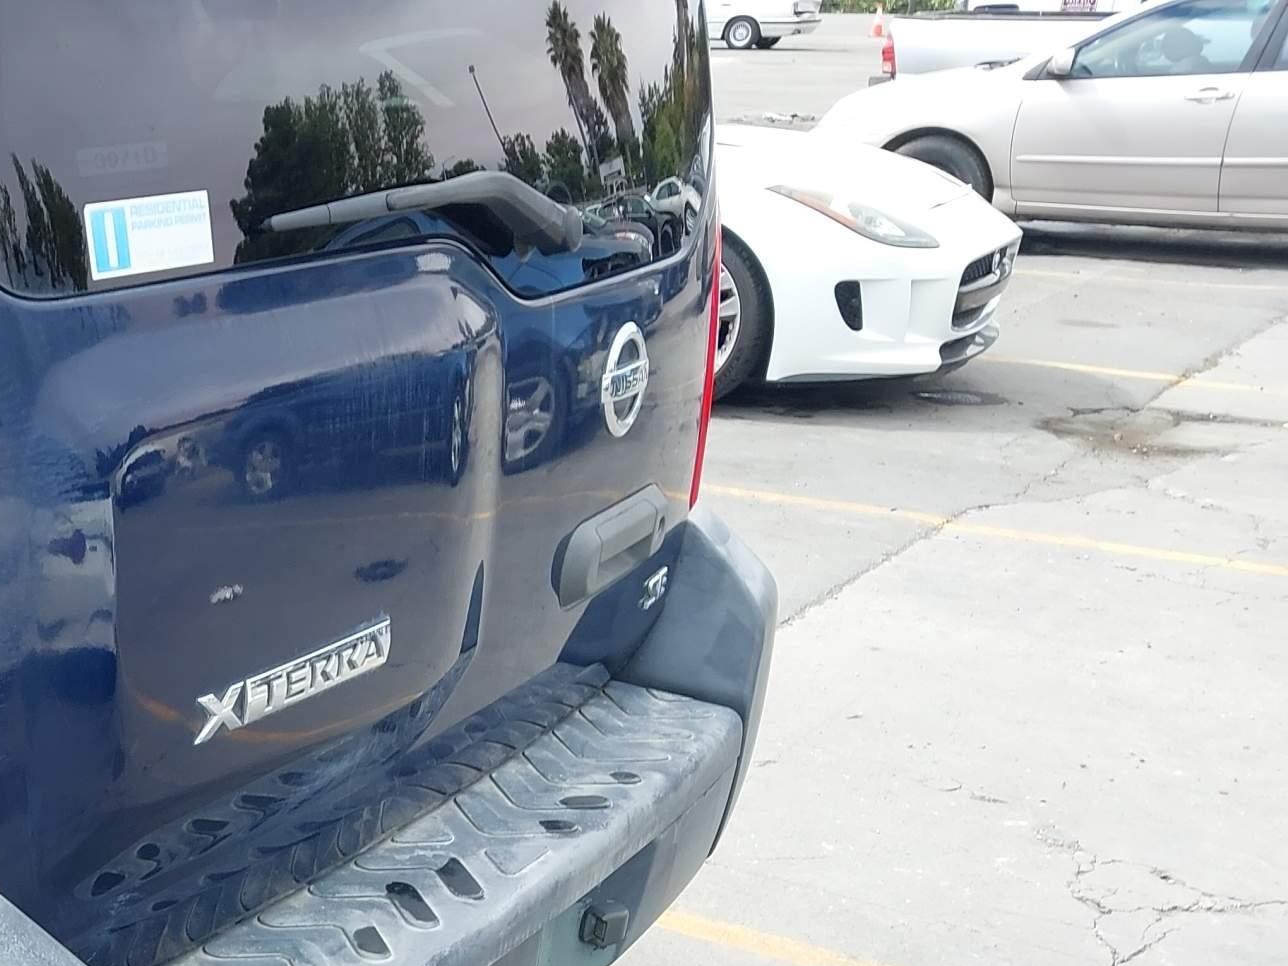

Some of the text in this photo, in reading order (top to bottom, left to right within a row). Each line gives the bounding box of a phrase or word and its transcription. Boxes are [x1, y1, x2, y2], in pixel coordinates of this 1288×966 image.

[129, 197, 206, 217] RESIDENTIAL
[131, 214, 173, 231] PARKING
[610, 364, 648, 398] NISSAN
[193, 618, 391, 746] XTERRA
